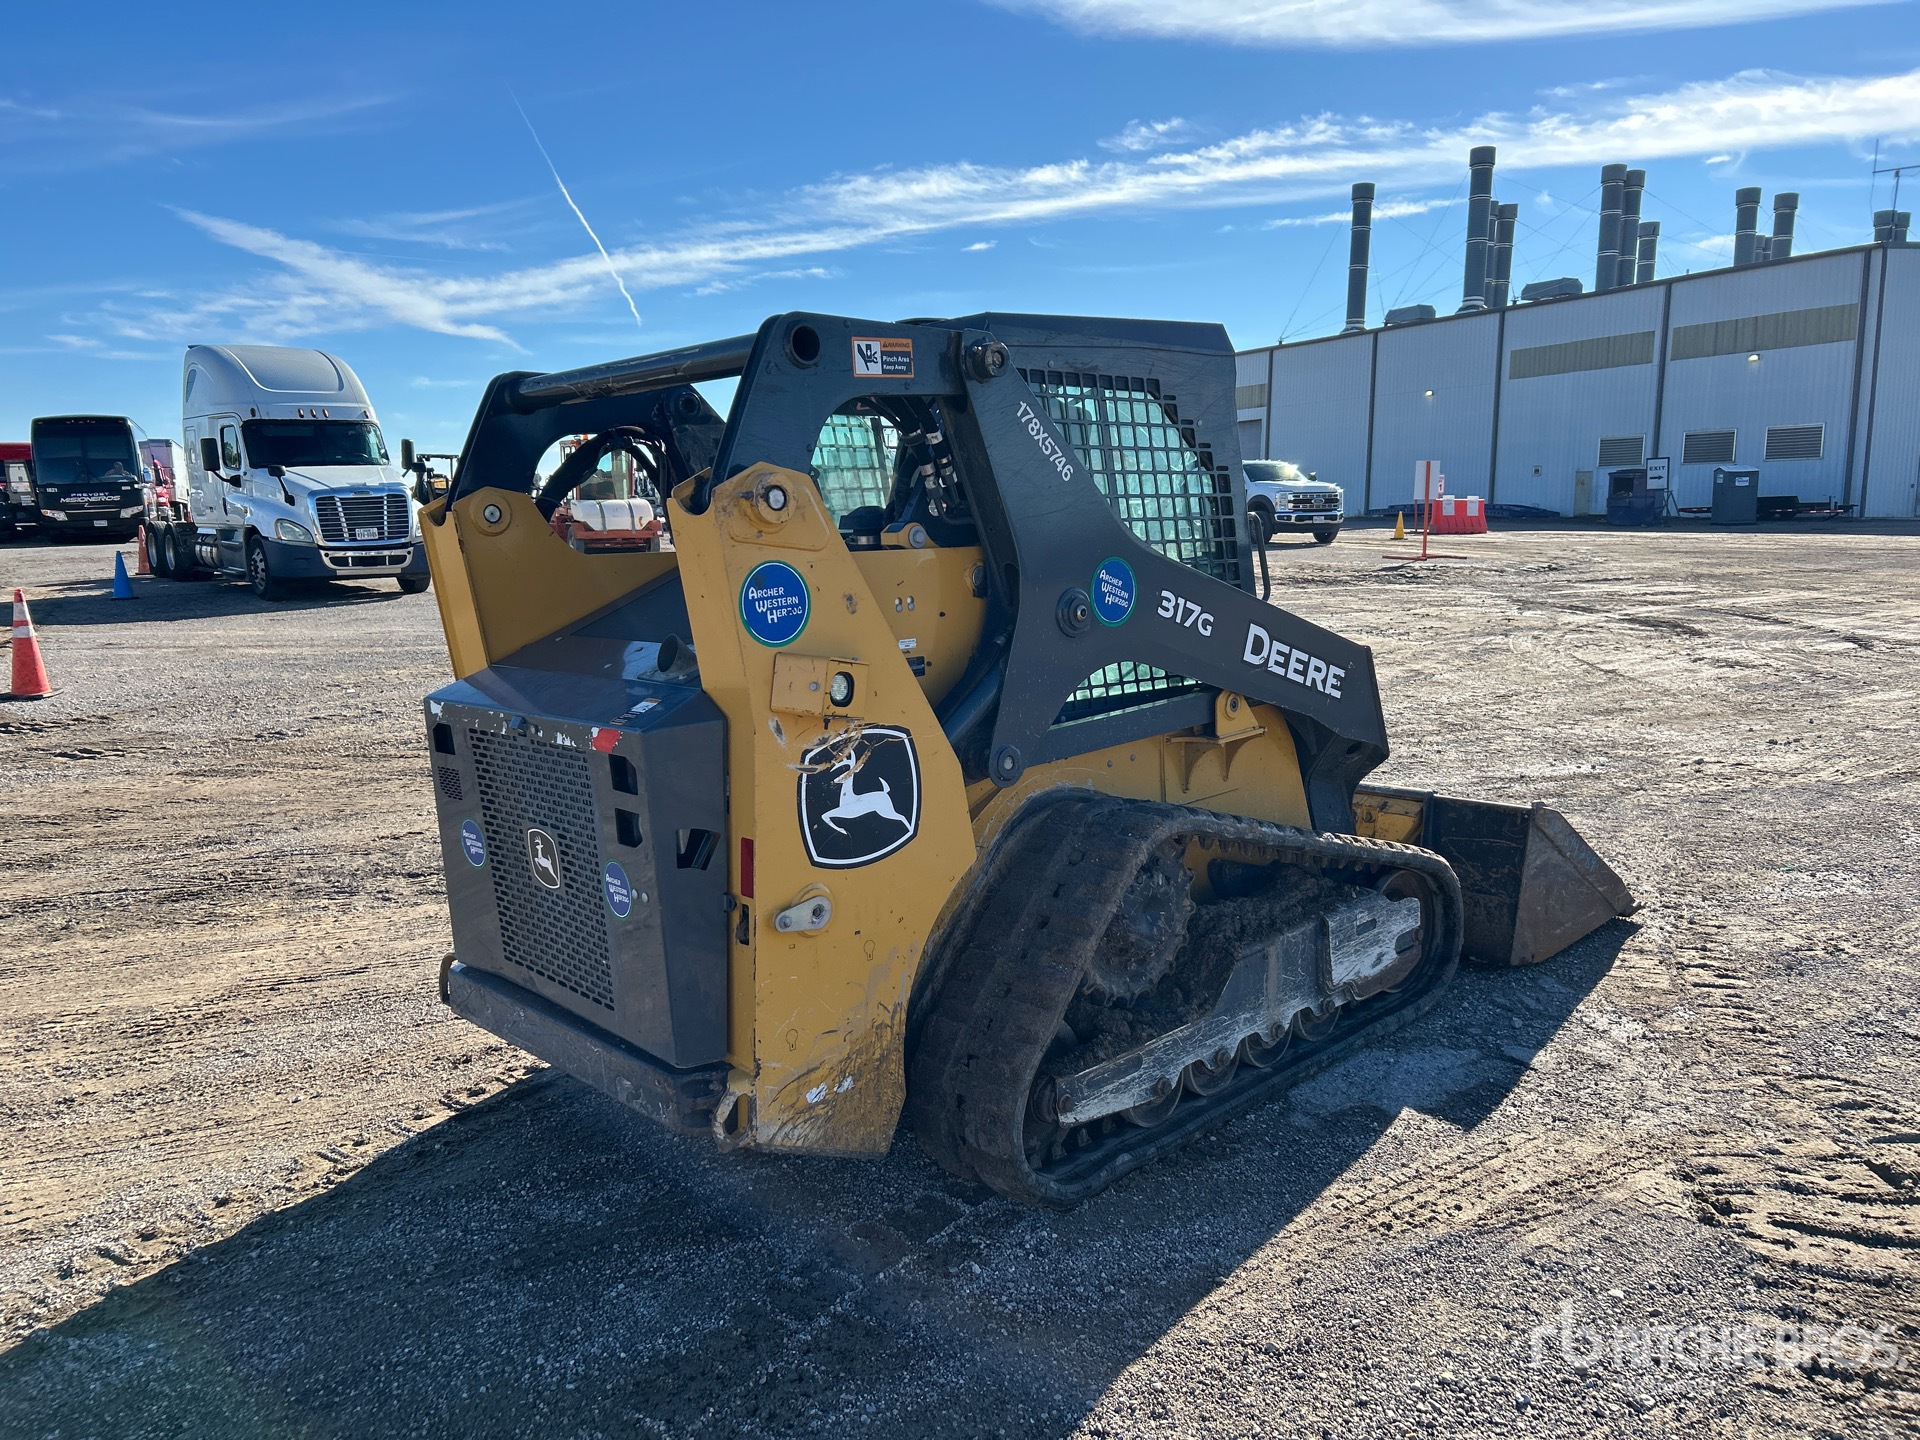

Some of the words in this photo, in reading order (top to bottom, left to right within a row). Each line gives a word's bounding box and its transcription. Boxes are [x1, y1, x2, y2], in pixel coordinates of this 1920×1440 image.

[883, 355, 898, 363] Pinch
[1017, 401, 1074, 482] 178X5746
[1099, 569, 1122, 587] ARCHER
[748, 586, 785, 600] ARCHER
[1101, 581, 1129, 599] WESTERN
[755, 596, 799, 613] WESTERN
[1105, 592, 1129, 608] HERZOG
[1157, 590, 1215, 637] 317G
[1243, 623, 1346, 699] DEERE
